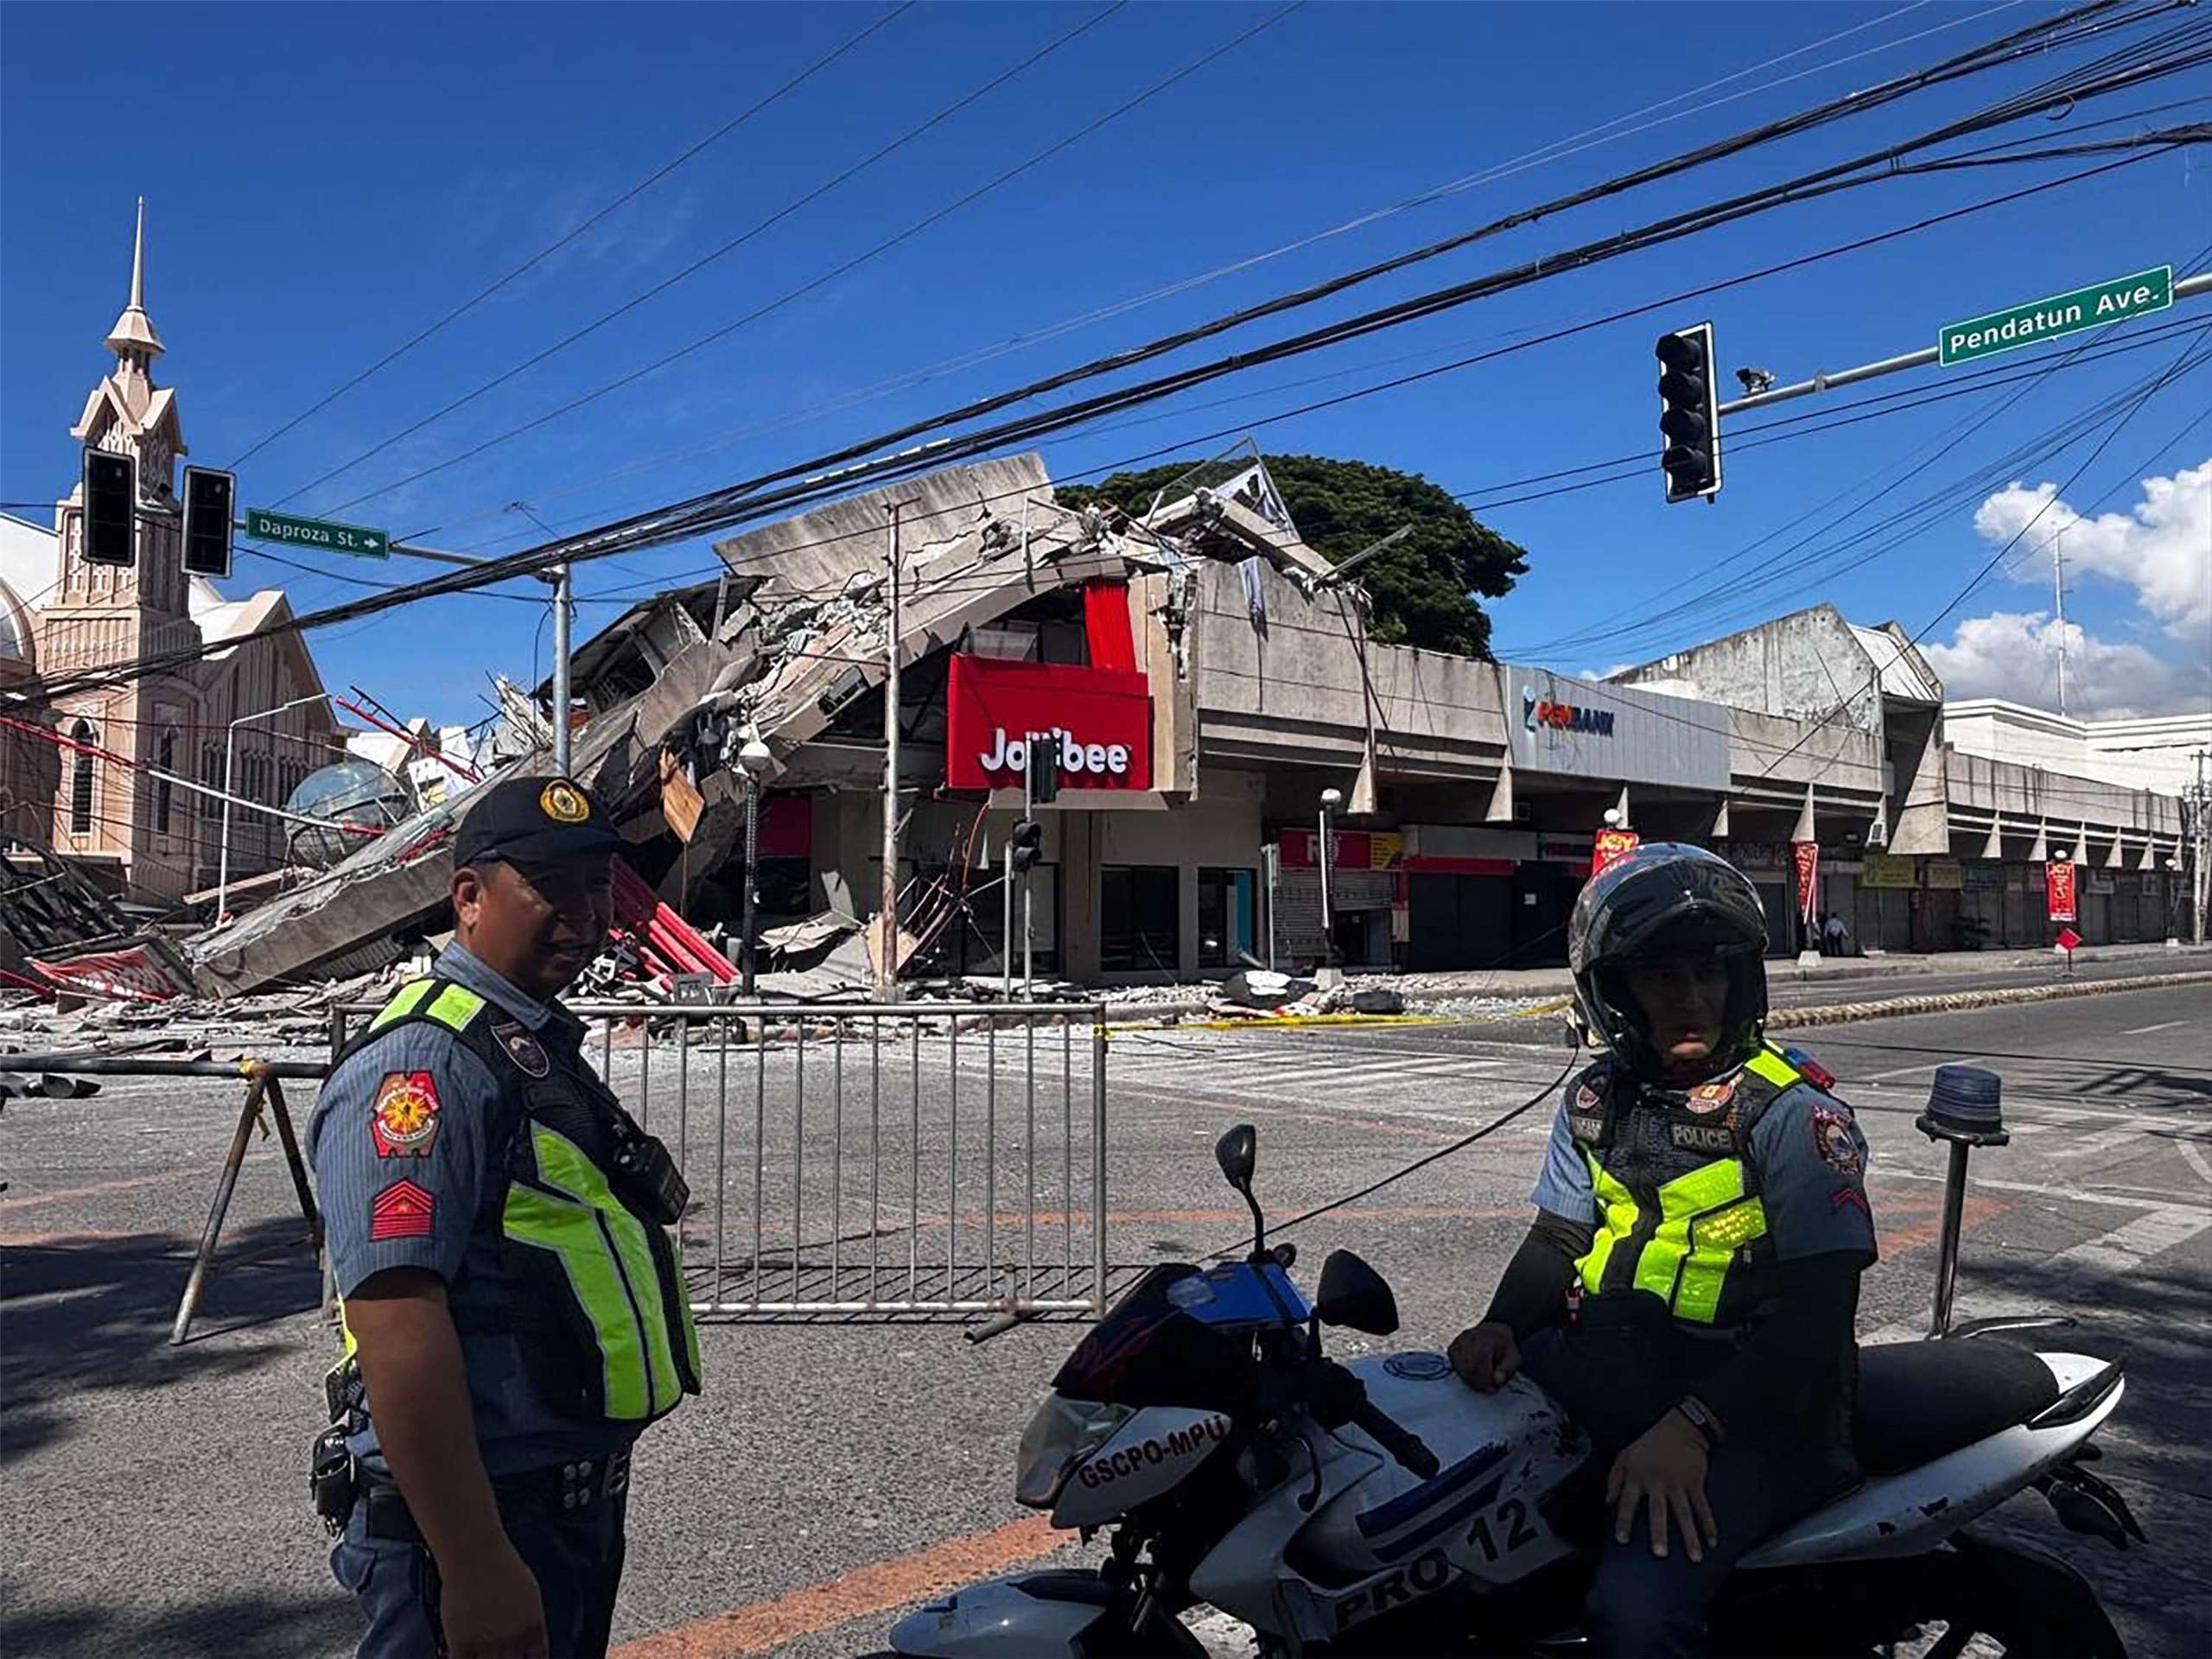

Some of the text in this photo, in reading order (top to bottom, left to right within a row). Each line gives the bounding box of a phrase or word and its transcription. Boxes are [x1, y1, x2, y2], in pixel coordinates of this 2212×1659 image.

[1950, 285, 2159, 353] Pendatun Ave.
[259, 518, 358, 547] Daproza St.
[981, 727, 1128, 773] Joibee
[1673, 1125, 1732, 1149] POLICE
[1078, 1414, 1225, 1489] GSCPO-MPU
[1335, 1497, 1539, 1628] PRO 12
